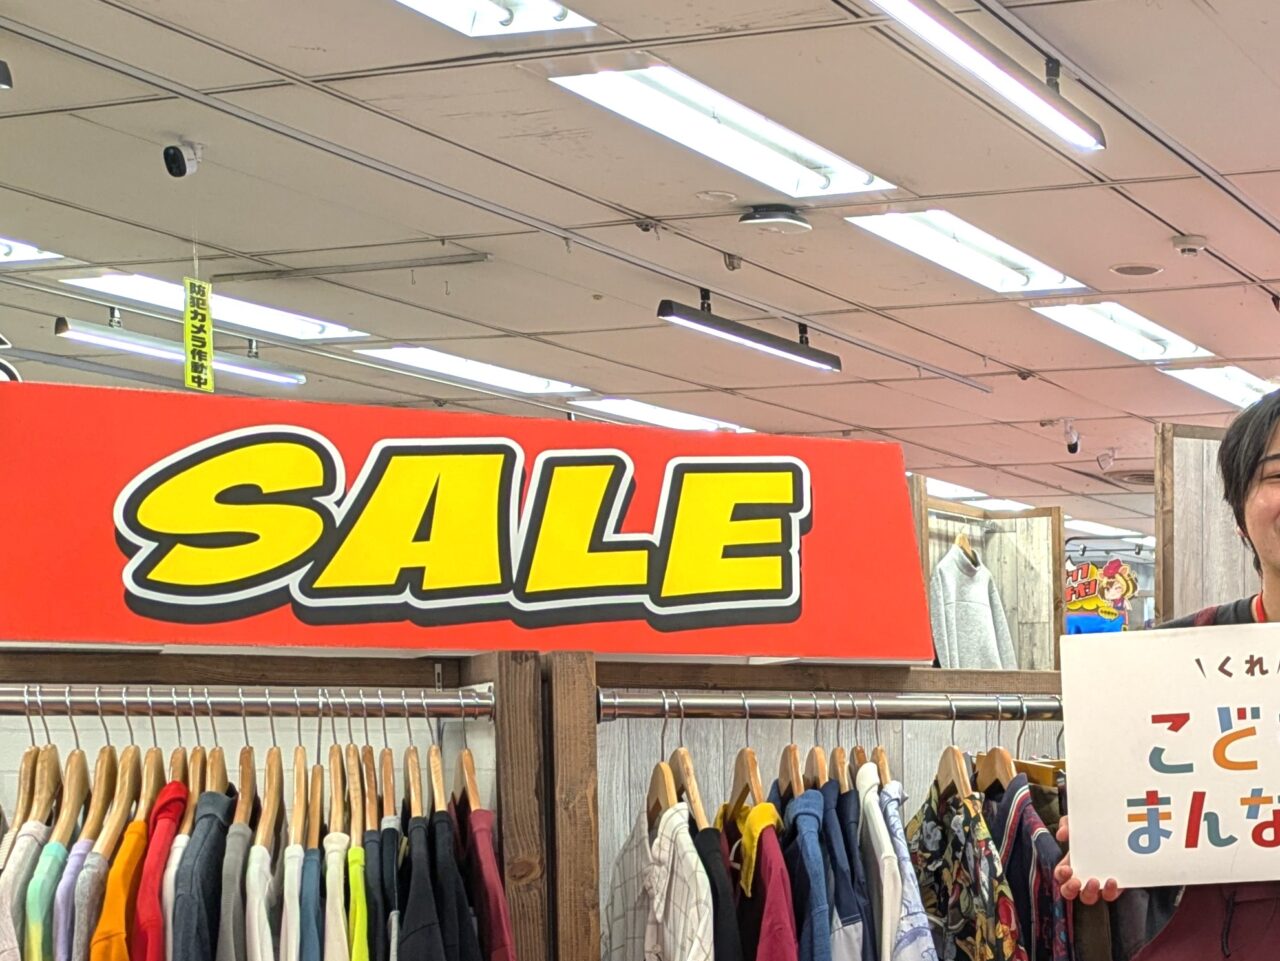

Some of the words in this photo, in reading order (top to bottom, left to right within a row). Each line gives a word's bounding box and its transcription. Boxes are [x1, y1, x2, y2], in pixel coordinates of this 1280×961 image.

[188, 282, 209, 389] 防犯カメラ作動中
[122, 430, 806, 618] SALE
